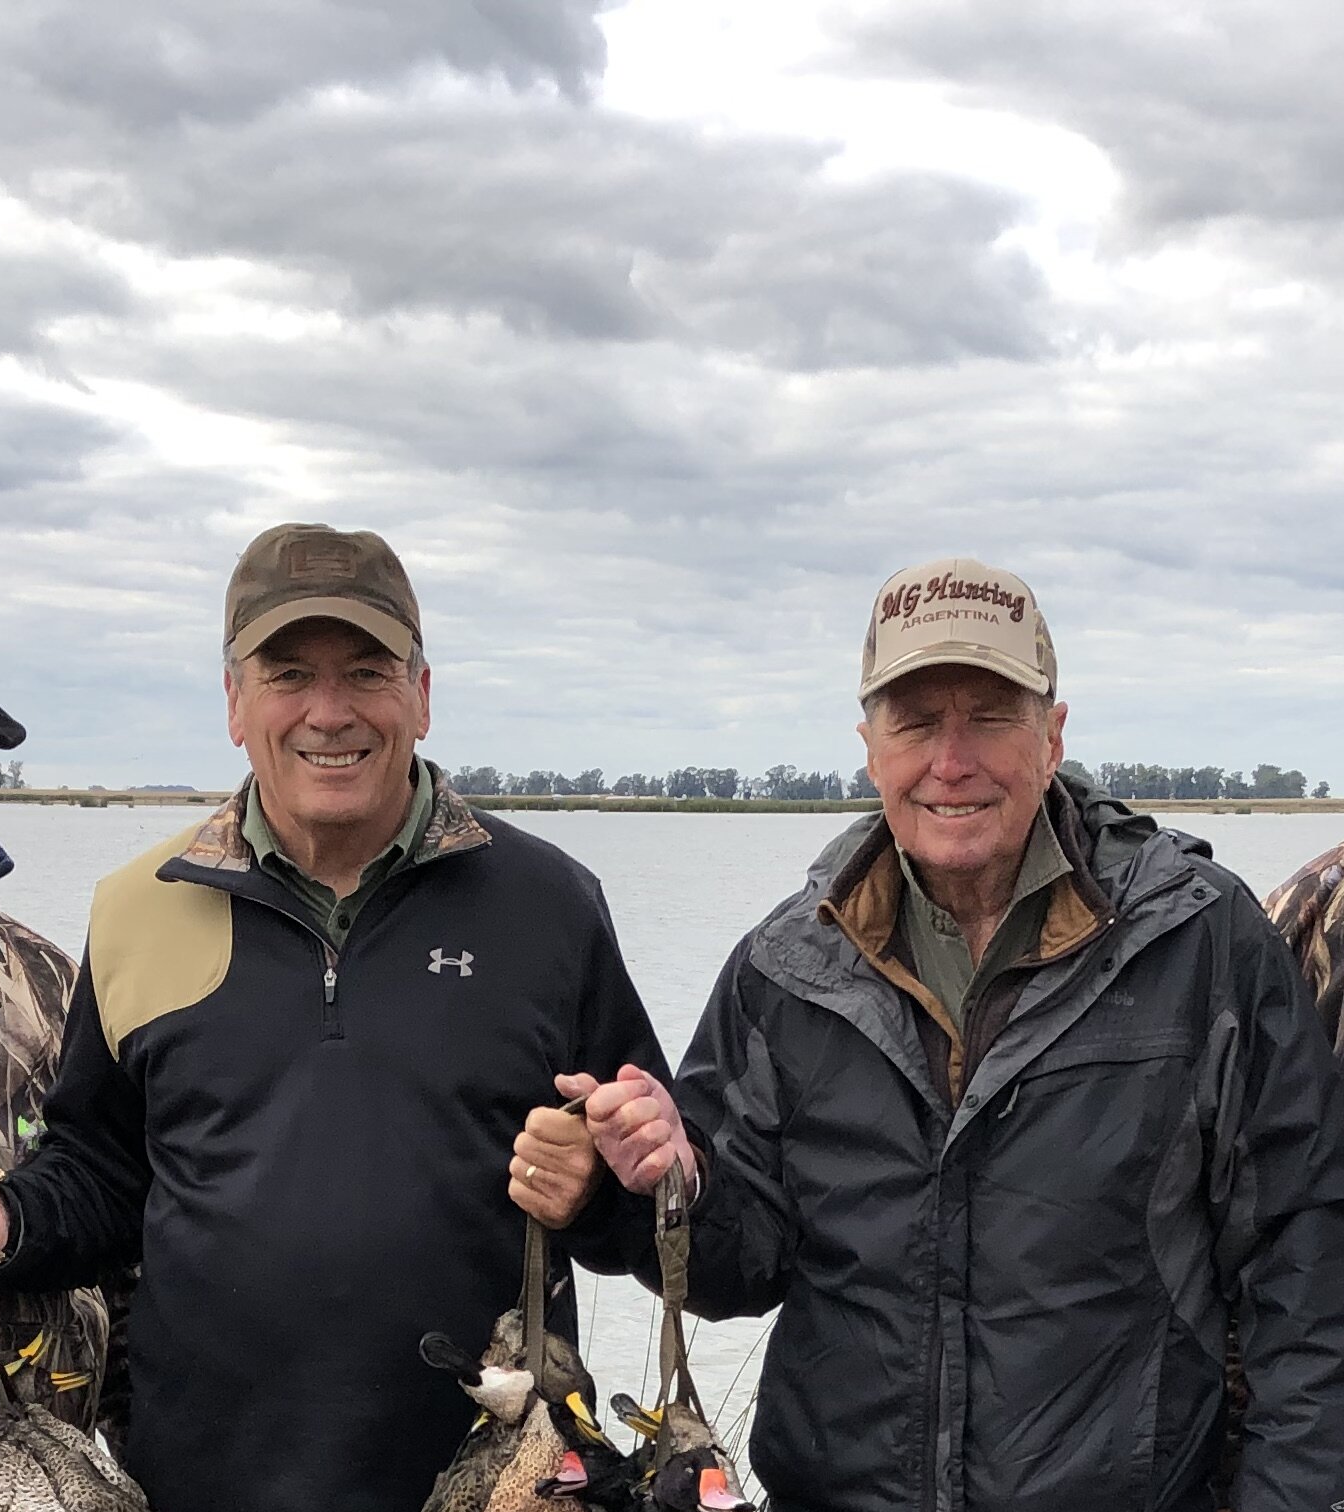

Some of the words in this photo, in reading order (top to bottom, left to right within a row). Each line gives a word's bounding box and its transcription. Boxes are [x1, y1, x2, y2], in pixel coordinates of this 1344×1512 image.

[879, 583, 922, 625] MG
[923, 572, 1026, 622] Hunting
[901, 609, 999, 632] ARGENTINA
